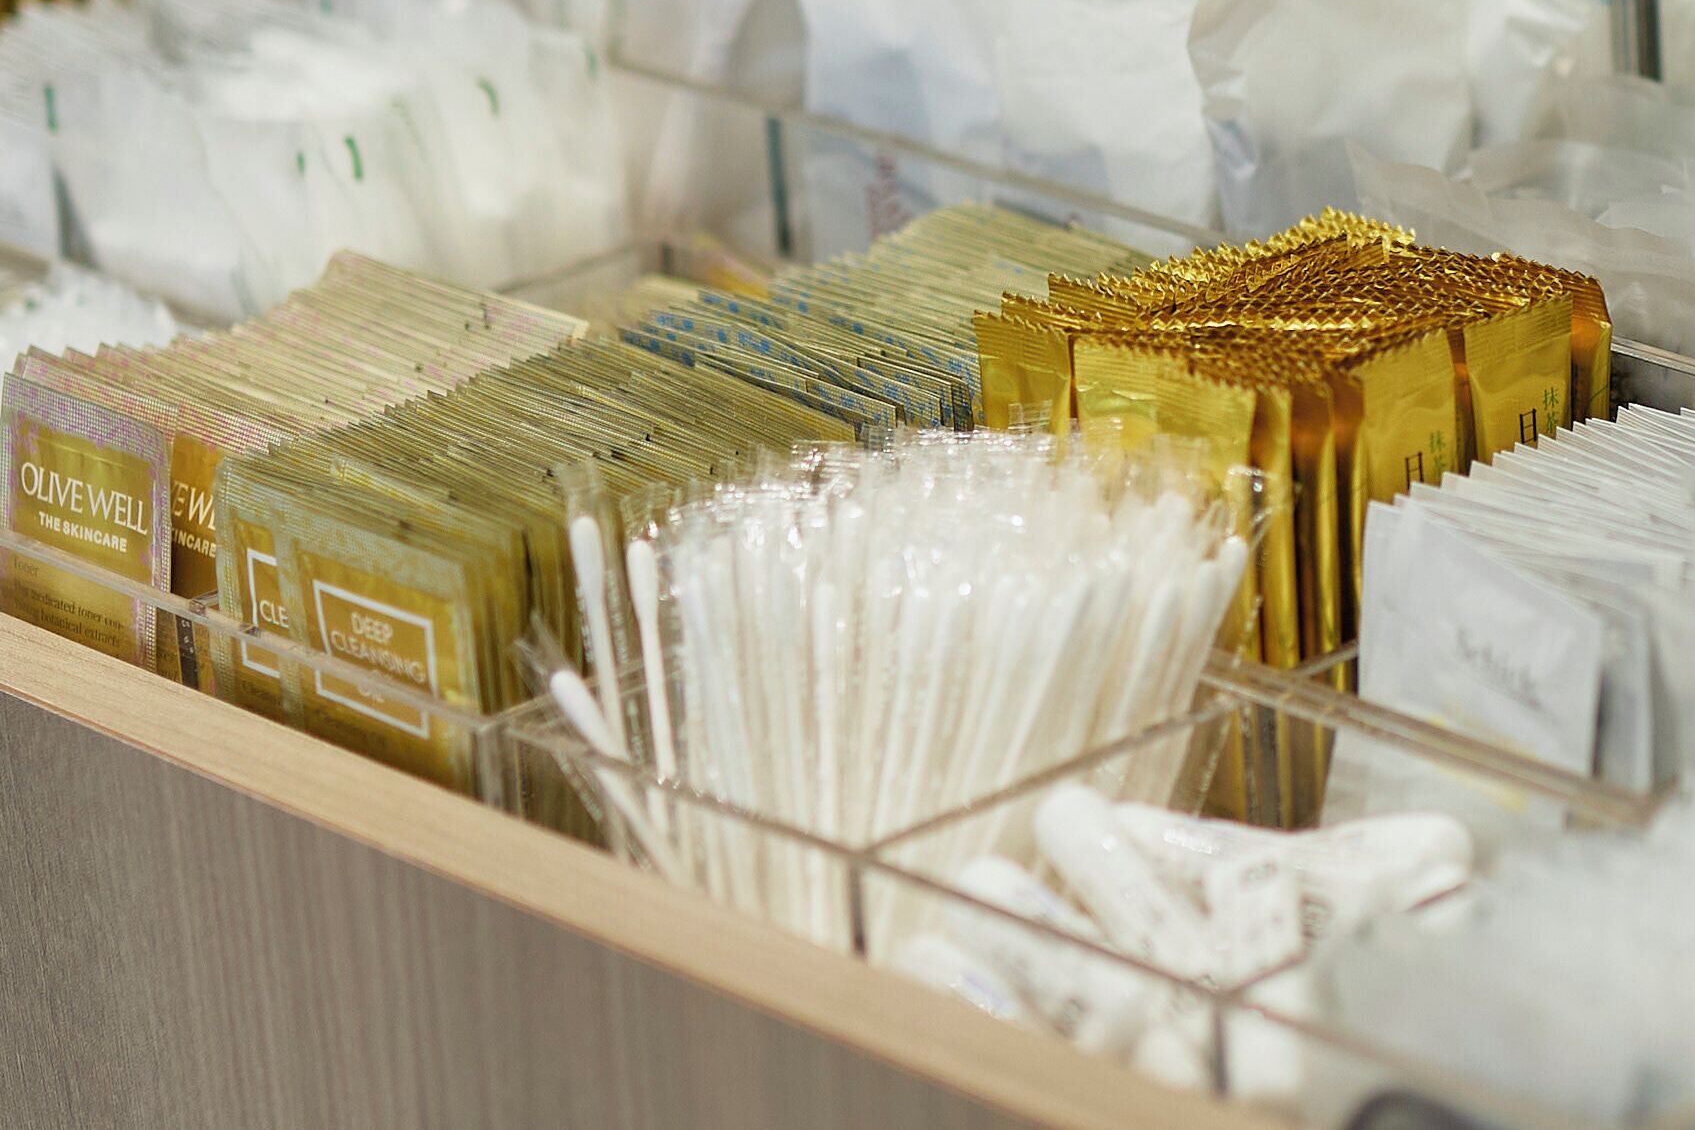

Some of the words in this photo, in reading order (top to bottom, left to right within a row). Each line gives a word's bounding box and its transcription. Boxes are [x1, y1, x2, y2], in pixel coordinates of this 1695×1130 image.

[20, 461, 84, 515] OLIVE
[86, 483, 148, 536] WELL
[38, 511, 61, 534] THE
[62, 520, 128, 553] SKINCARE
[350, 611, 394, 643] DEEP
[330, 629, 425, 683] CLEANSING
